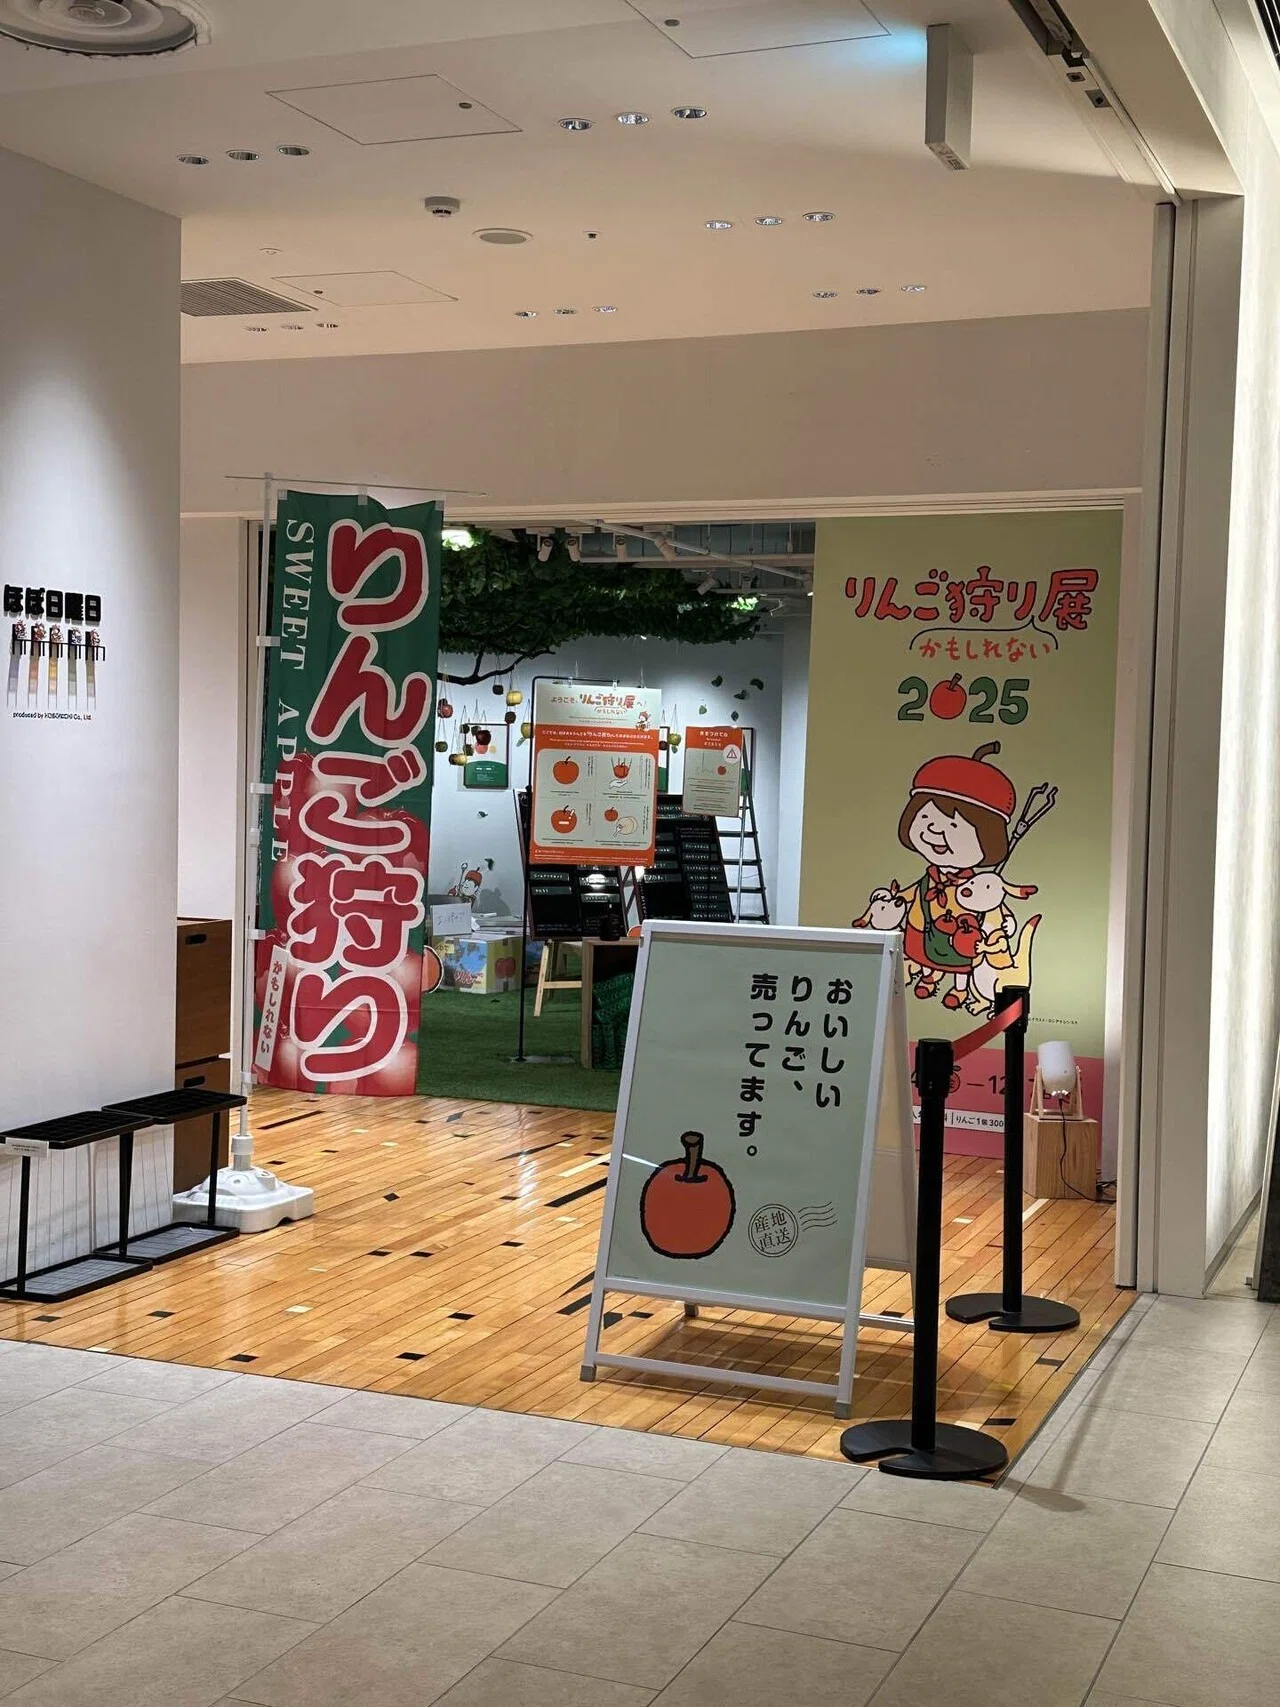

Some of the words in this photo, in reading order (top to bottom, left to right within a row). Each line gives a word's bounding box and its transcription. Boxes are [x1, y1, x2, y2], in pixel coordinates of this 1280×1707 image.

[279, 519, 315, 671] SWEET
[845, 565, 1099, 631] りんご狩り展
[919, 635, 1051, 662] かもしれない
[271, 697, 300, 863] APPLE
[288, 518, 432, 1082] りんご狩り
[260, 960, 283, 1055] かもしれない
[736, 973, 779, 1157] 売ってます。
[781, 975, 813, 1091] りんご、
[815, 978, 853, 1108] おいしい
[754, 1210, 788, 1233] 産地
[759, 1227, 791, 1252] 直送
